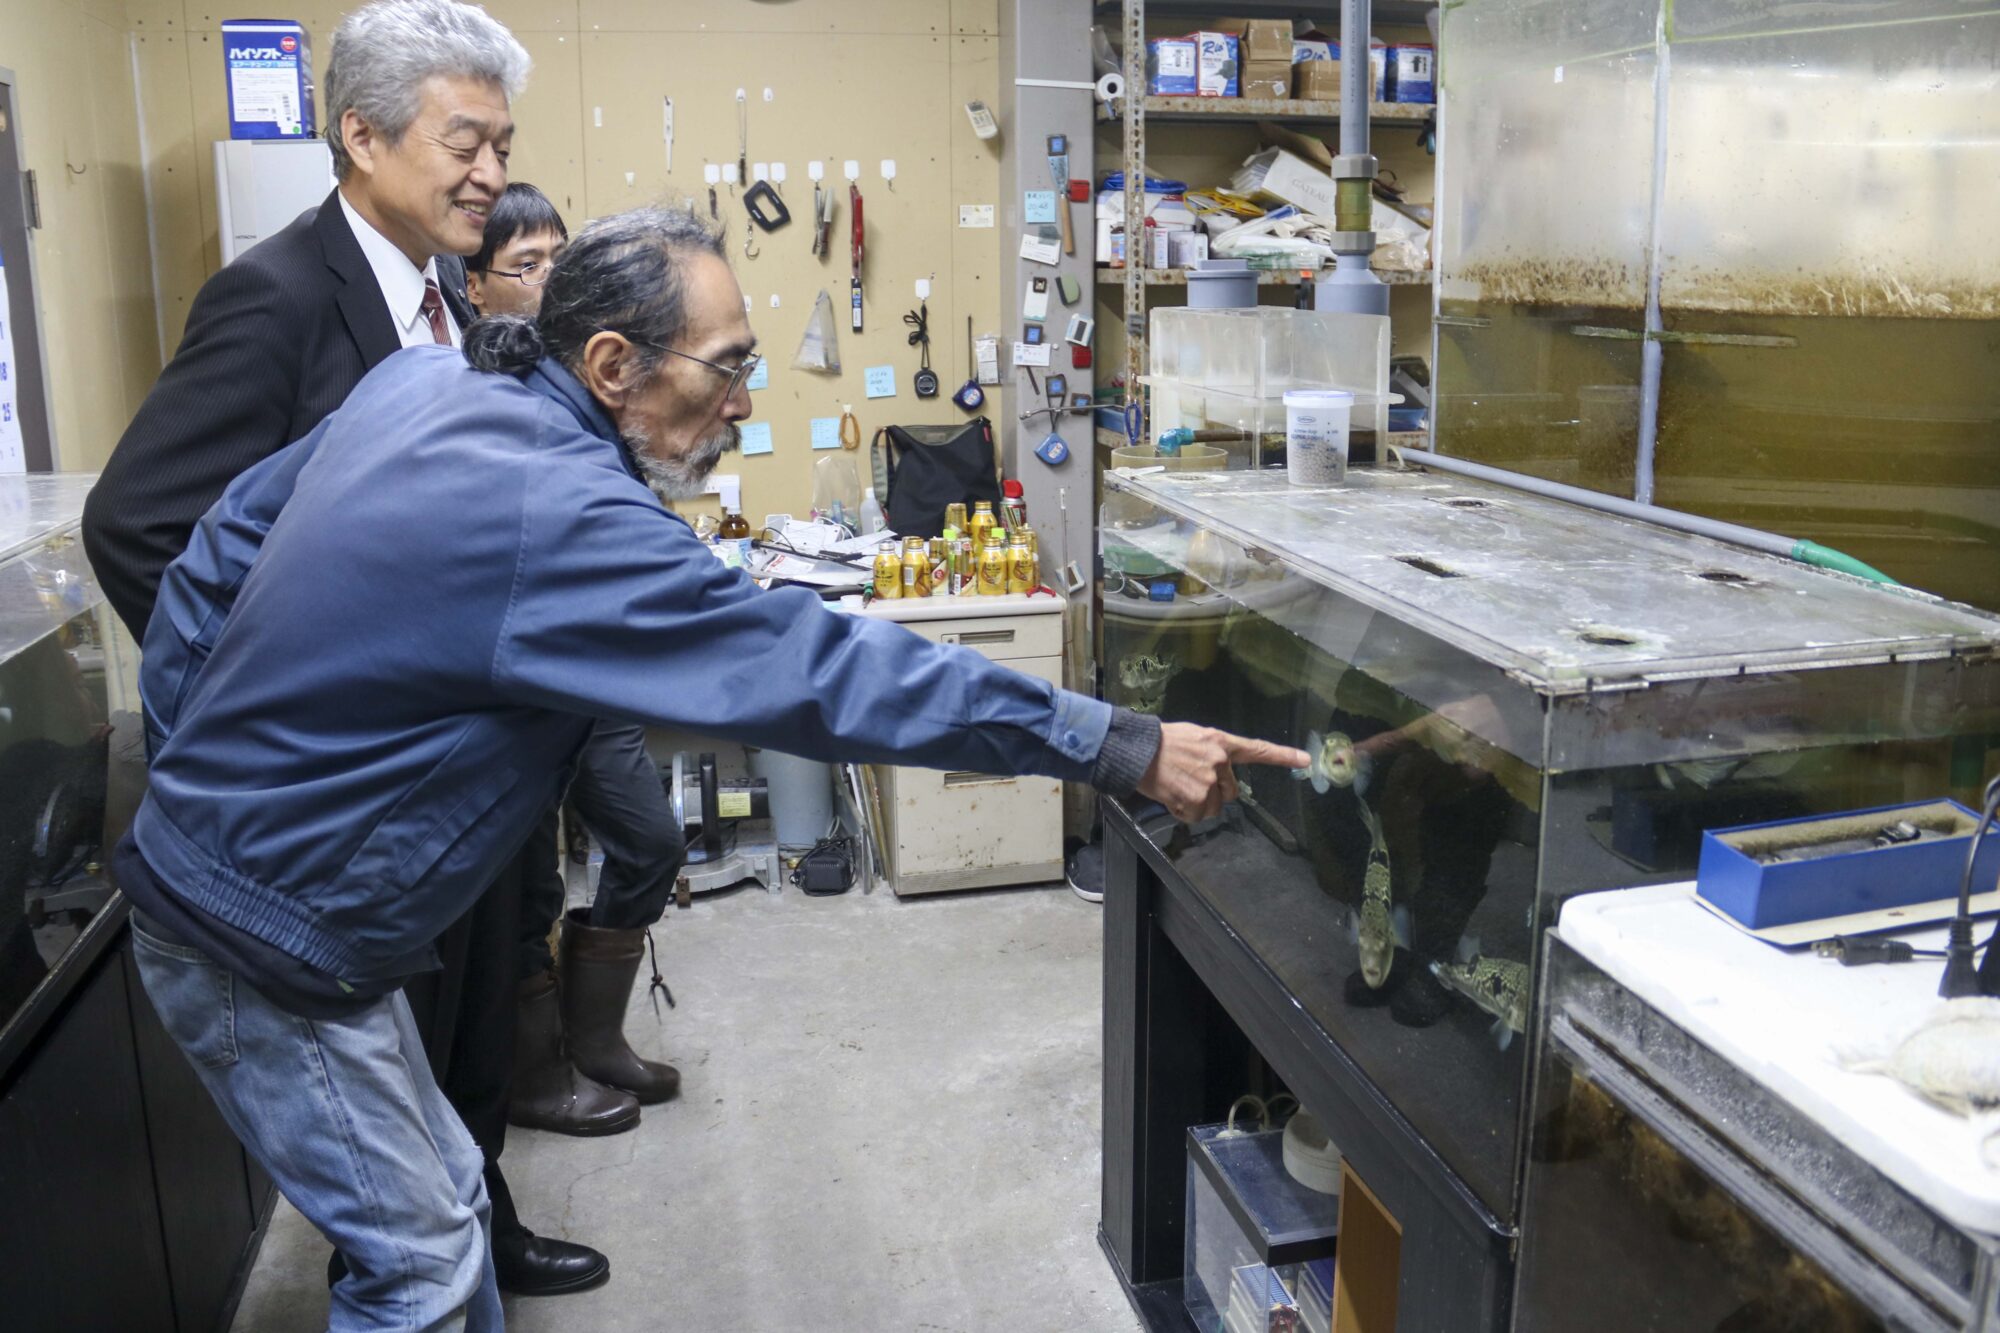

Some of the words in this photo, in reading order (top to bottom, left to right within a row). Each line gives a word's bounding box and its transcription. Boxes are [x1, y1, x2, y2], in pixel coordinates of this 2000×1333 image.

[229, 48, 282, 59] ハイソフト
[1291, 178, 1330, 203] GATEAU
